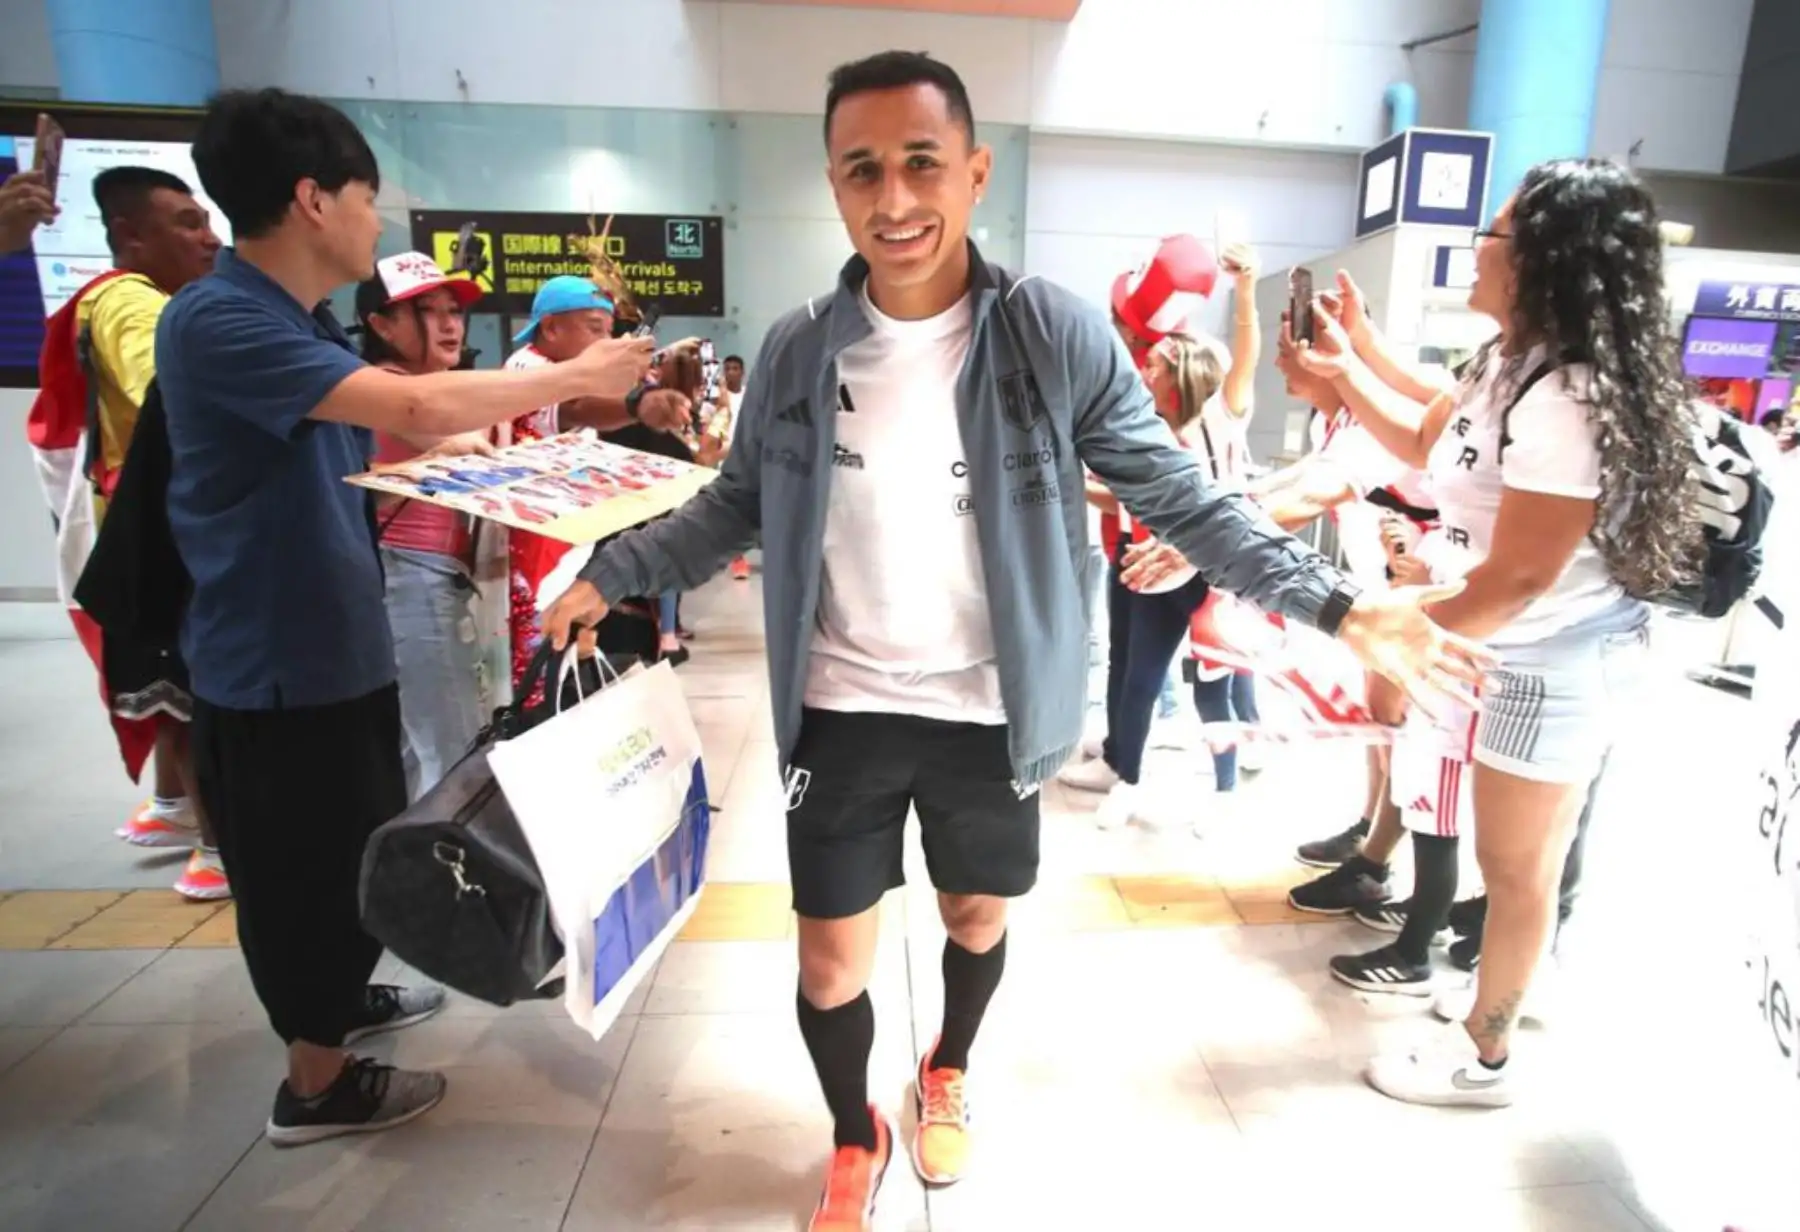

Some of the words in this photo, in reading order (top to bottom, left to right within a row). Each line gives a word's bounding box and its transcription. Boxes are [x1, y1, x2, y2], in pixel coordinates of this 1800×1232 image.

[675, 224, 695, 244] 北
[505, 259, 592, 275] Internation
[1688, 340, 1769, 358] EXCHANGE
[1003, 448, 1052, 471] Claro
